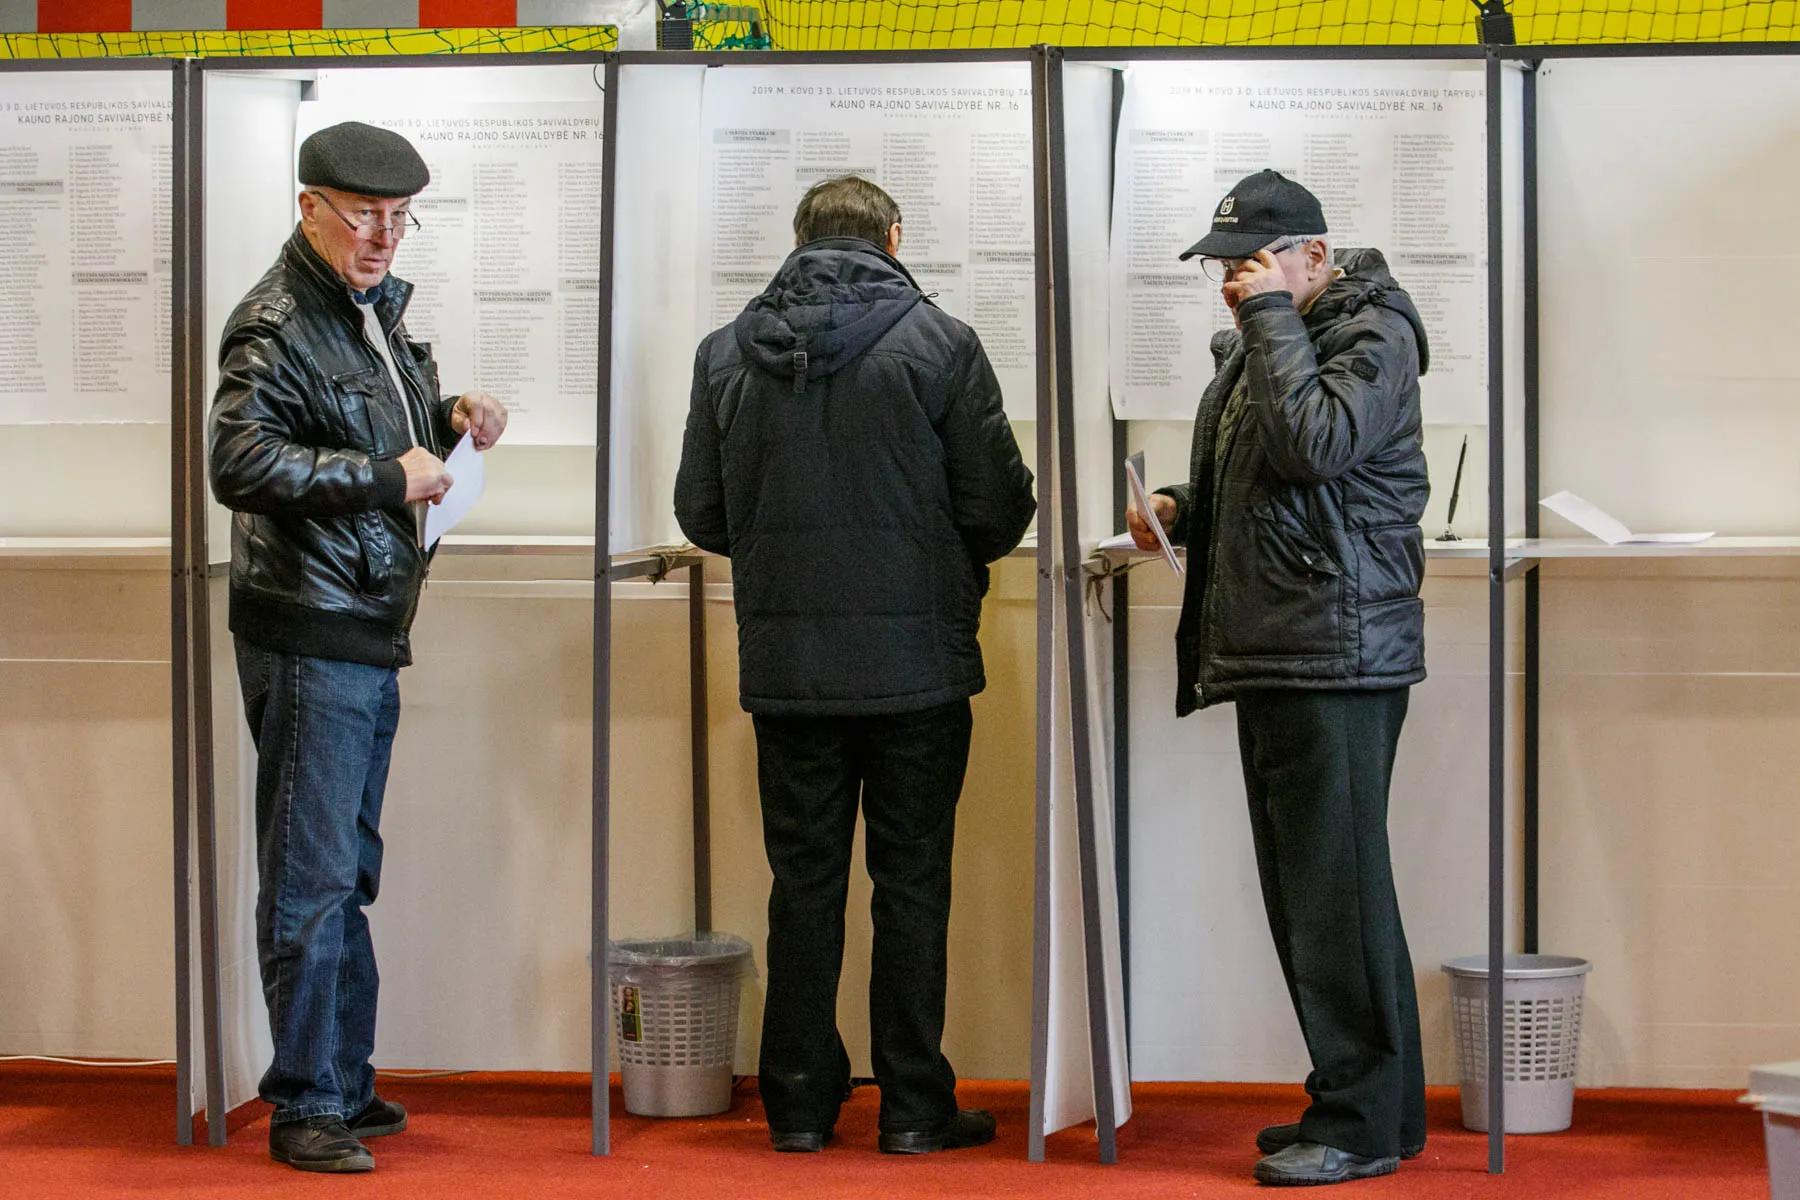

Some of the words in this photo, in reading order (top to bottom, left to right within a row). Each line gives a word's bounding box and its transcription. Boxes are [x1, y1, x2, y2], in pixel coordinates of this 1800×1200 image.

[752, 86, 773, 95] 2019
[790, 87, 814, 95] KOVO
[817, 87, 823, 95] 3
[838, 87, 882, 96] LIETUVOS
[886, 87, 948, 96] RESPUBLIKOS
[1209, 87, 1233, 96] KOVO
[1236, 87, 1242, 96] 3
[1257, 87, 1303, 96] LIETUVOS
[1306, 87, 1370, 96] RESPUBLIKOS
[25, 102, 67, 111] LIETUVOS
[70, 101, 129, 110] RESPUBLIKOS
[830, 99, 866, 110] KAUNO
[869, 99, 911, 110] RAJONO
[1008, 101, 1019, 111] 16
[1249, 100, 1286, 110] KAUNO
[1289, 100, 1333, 111] RAJONO
[1432, 102, 1444, 112] 16
[17, 115, 51, 124] KAUNO
[55, 114, 94, 124] RAJONO
[427, 119, 470, 127] LIETUVOS
[473, 118, 534, 127] RESPUBLIKOS
[420, 131, 454, 141] KAUNO
[457, 131, 499, 141] RAJONO
